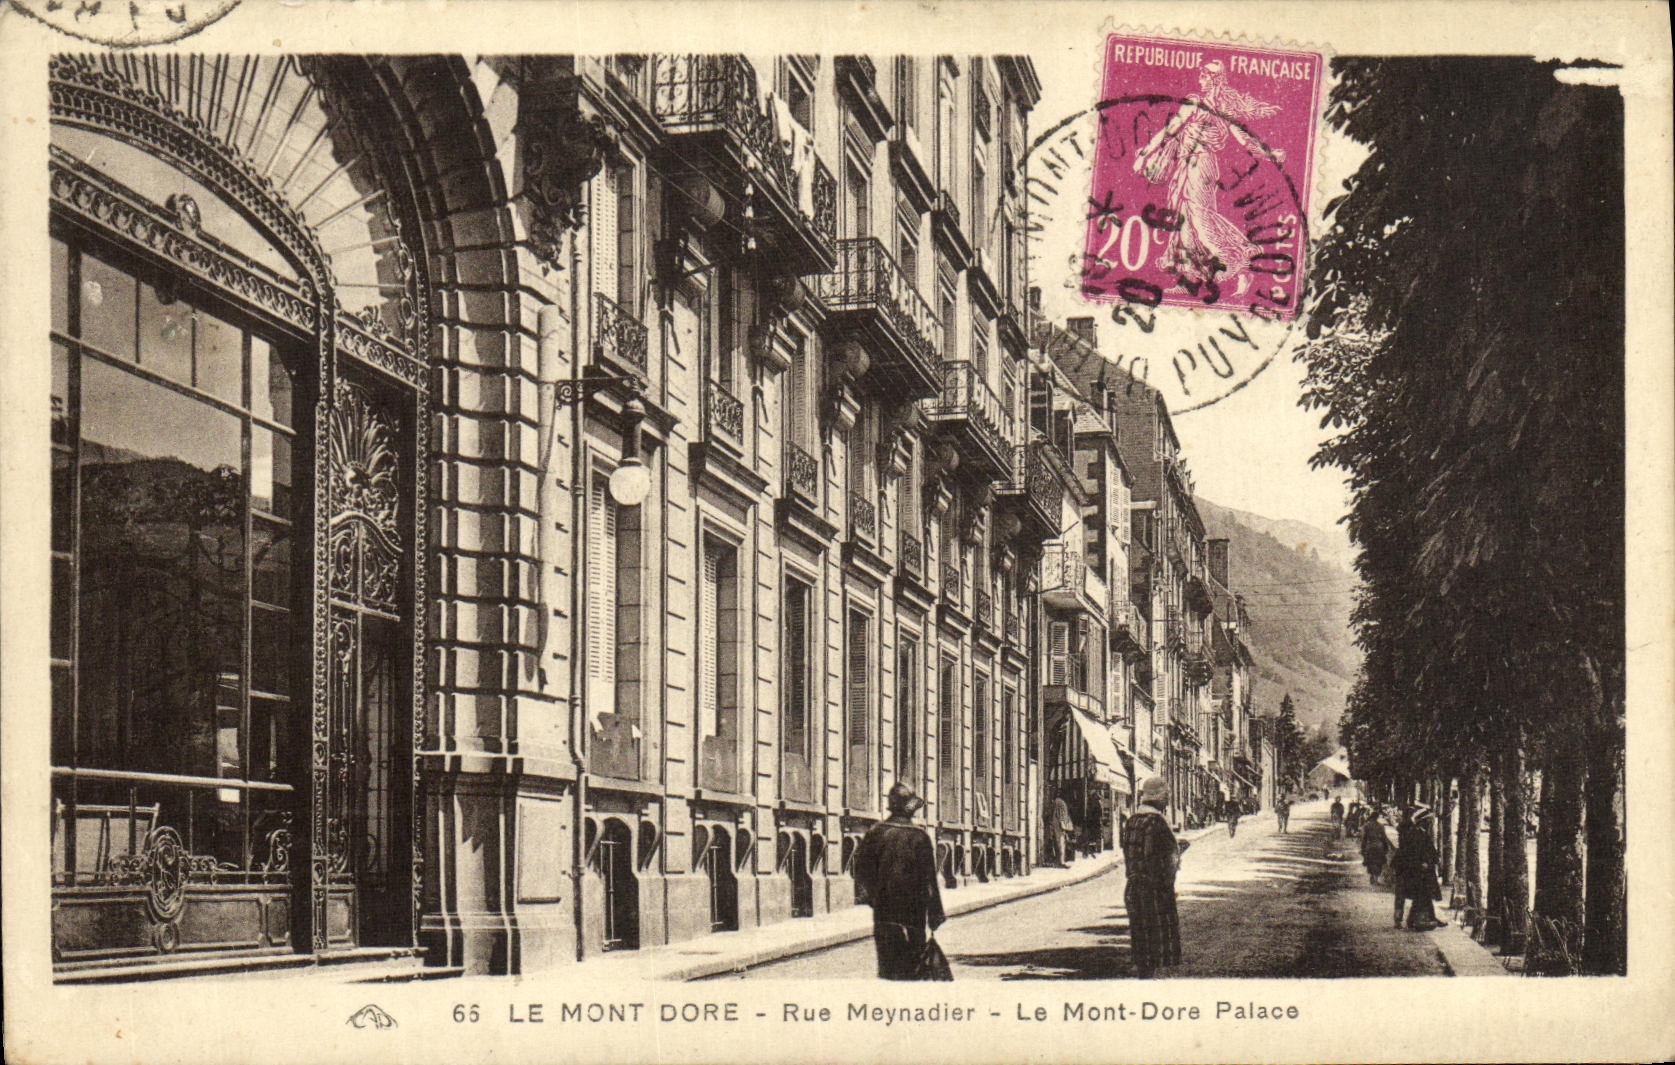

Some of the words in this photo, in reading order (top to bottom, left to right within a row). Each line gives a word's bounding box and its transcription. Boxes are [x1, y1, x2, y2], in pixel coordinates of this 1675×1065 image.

[1229, 55, 1312, 81] FRANÇAISE
[1271, 213, 1298, 299] POTES
[1172, 313, 1259, 398] PUY
